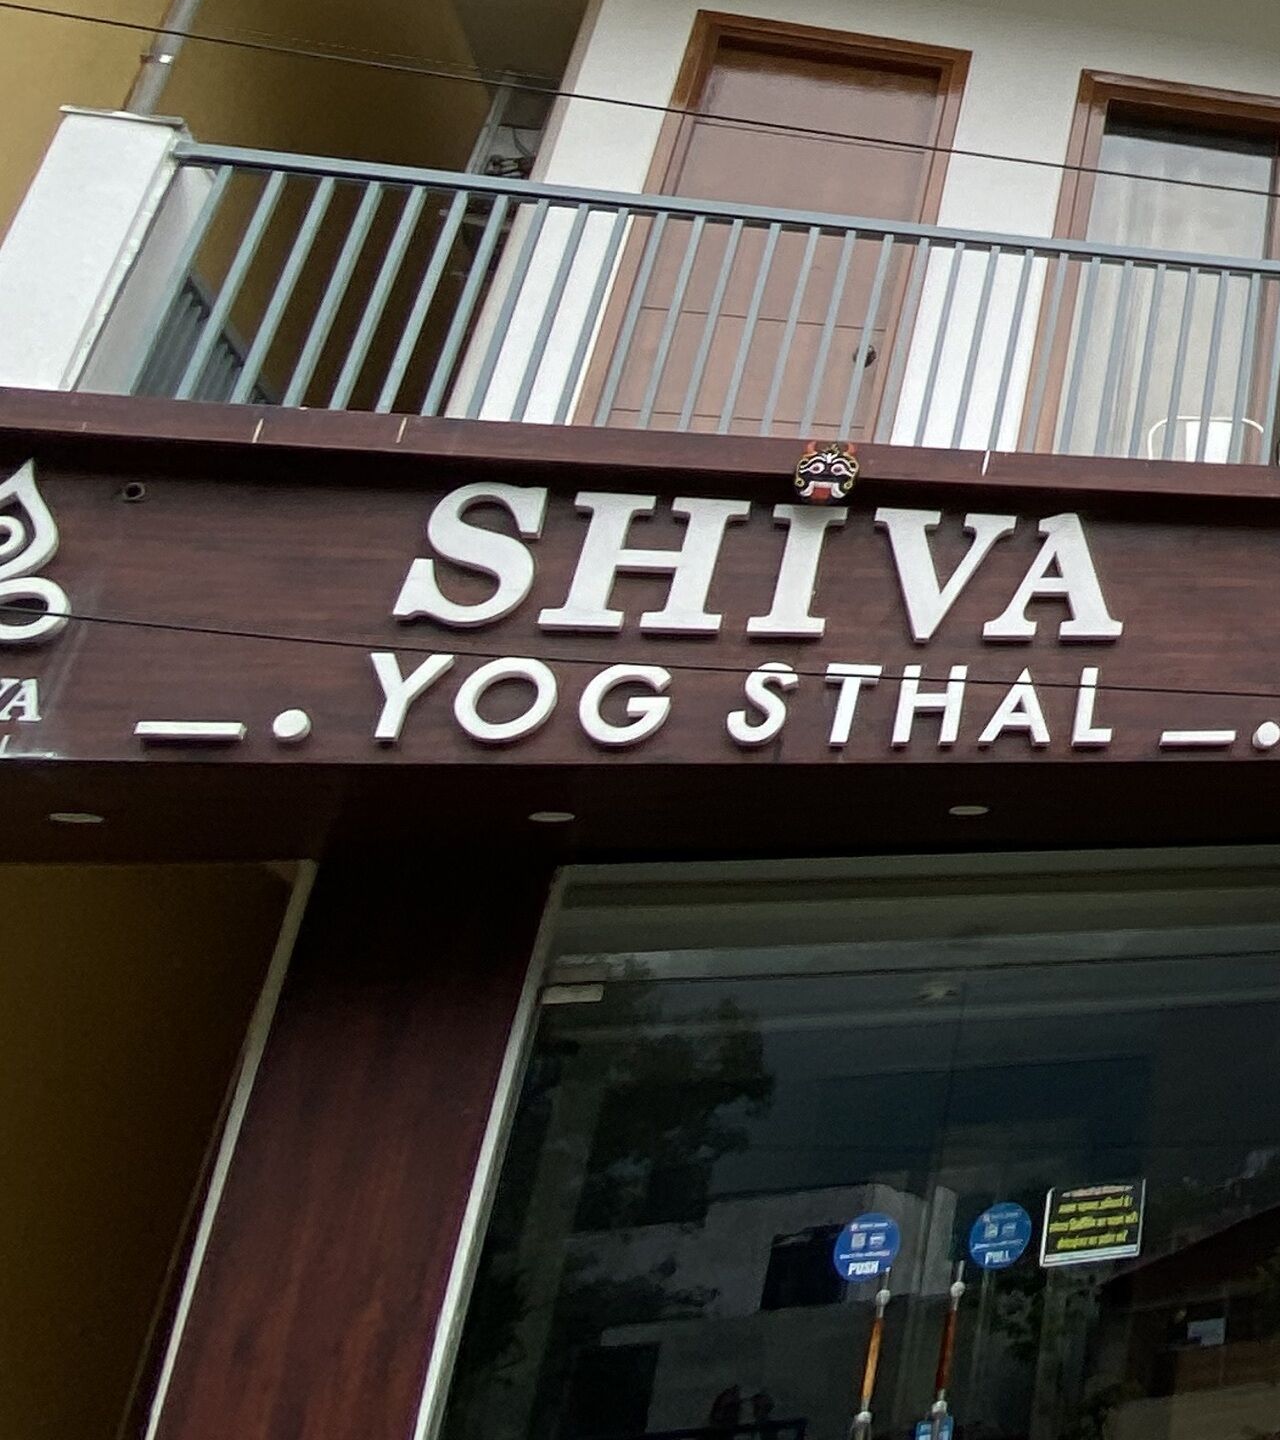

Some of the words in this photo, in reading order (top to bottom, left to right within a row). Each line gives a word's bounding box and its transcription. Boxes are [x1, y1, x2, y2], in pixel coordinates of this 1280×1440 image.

[391, 481, 1124, 643] SHIVA
[369, 653, 672, 746] YOG
[726, 662, 1114, 748] STHAL
[847, 1260, 880, 1276] PUSH
[984, 1250, 1011, 1265] PULL
